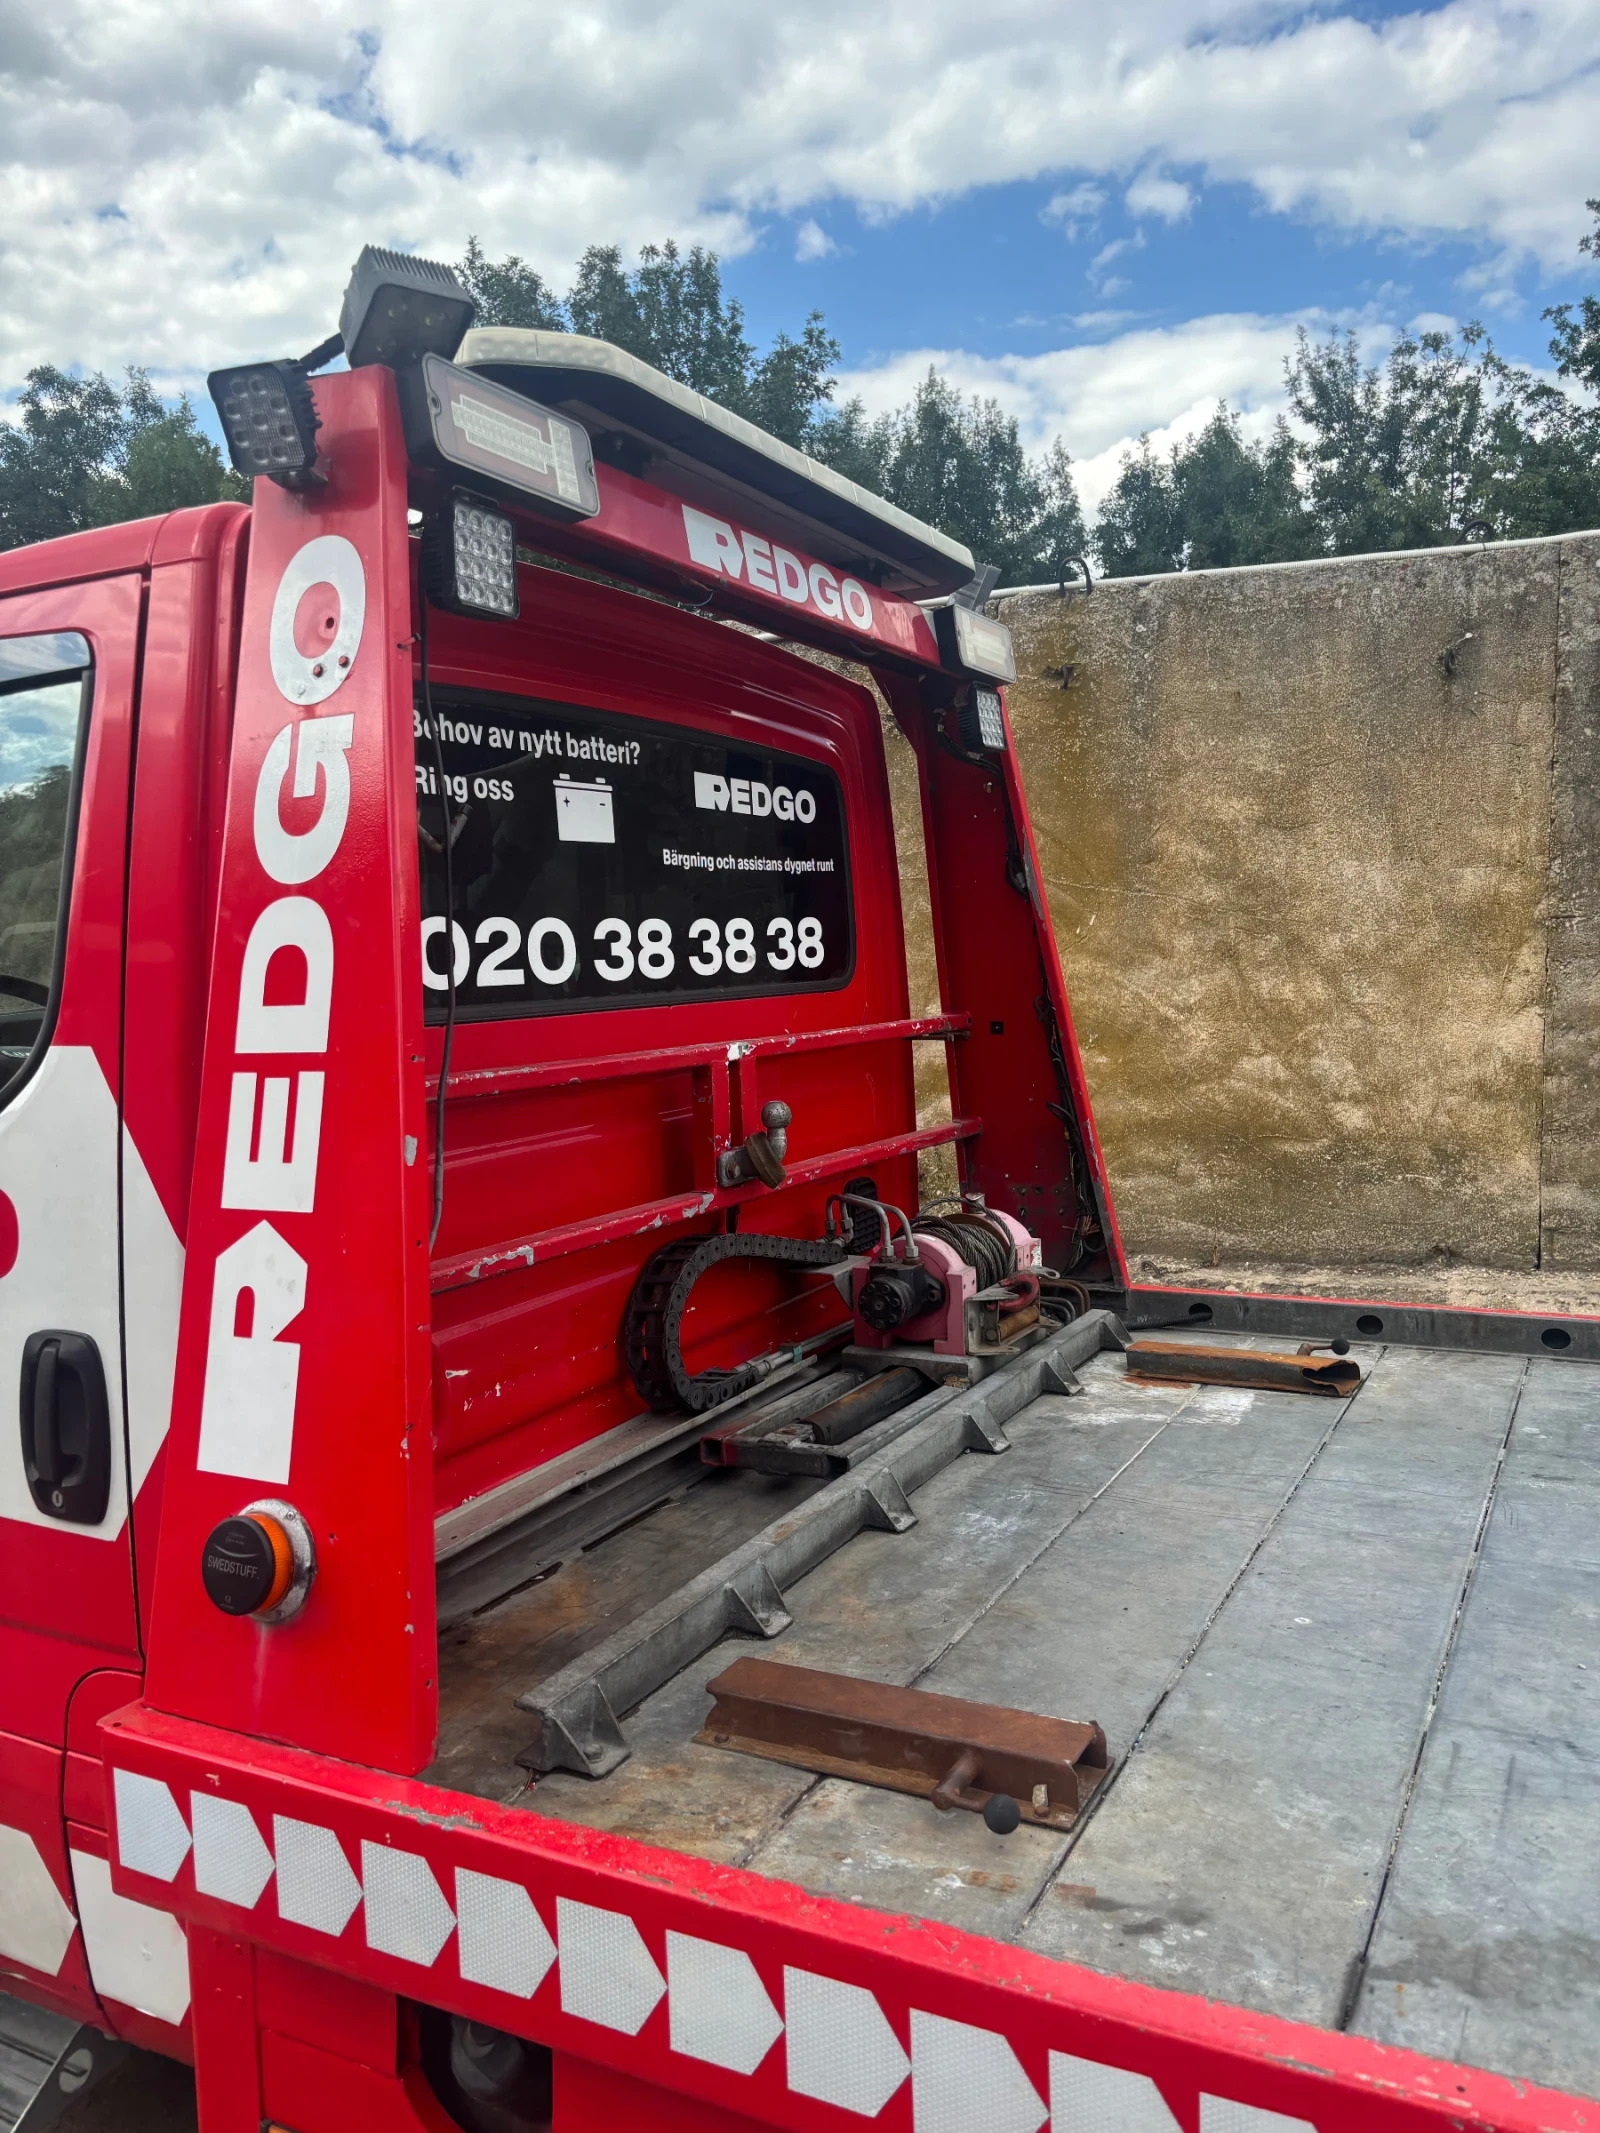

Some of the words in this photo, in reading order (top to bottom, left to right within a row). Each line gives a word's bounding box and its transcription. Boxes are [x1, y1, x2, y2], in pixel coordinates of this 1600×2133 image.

[681, 504, 872, 630] REDGO
[488, 726, 514, 749] av
[519, 730, 562, 759] nytt
[566, 732, 641, 765] batteri?
[473, 777, 514, 802] oss
[693, 771, 817, 824] REDGO
[663, 848, 714, 872] Bärgning
[716, 854, 736, 870] och
[737, 856, 783, 872] assistans
[784, 857, 816, 875] dygnet
[816, 858, 835, 872] runt
[420, 915, 577, 991] 020
[593, 917, 675, 982] 38
[688, 917, 756, 976] 38
[766, 916, 825, 971] 38
[197, 535, 366, 1484] REDGO
